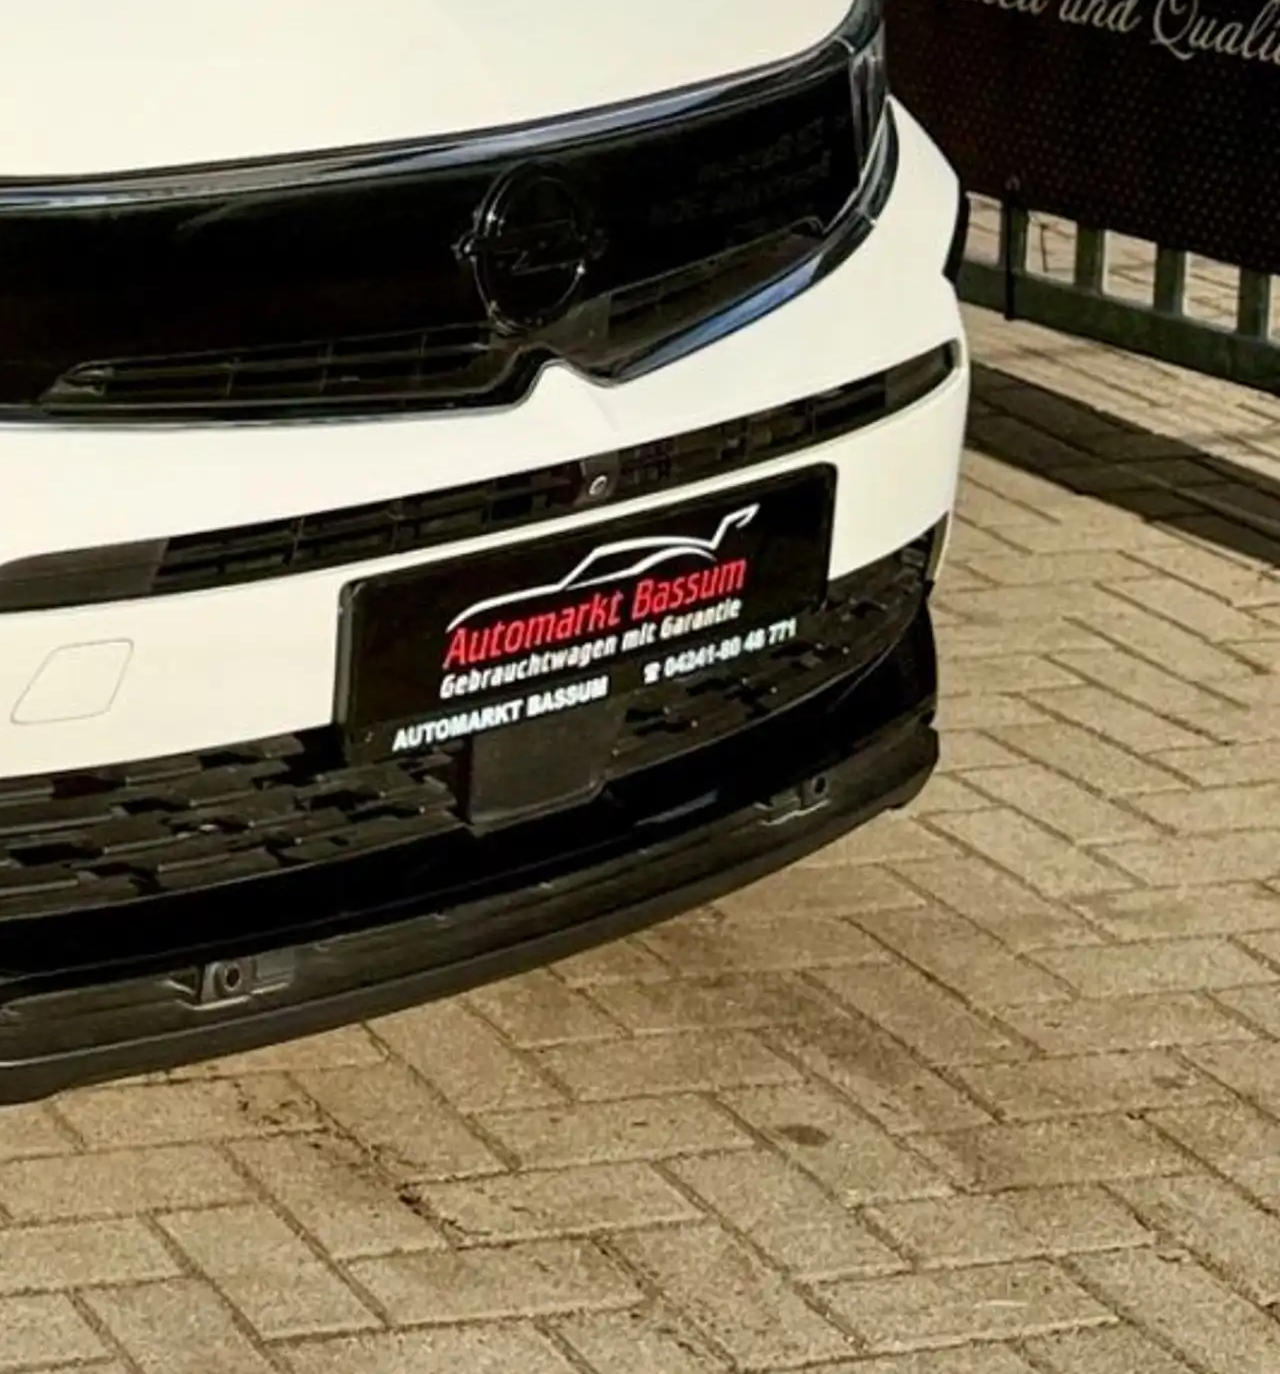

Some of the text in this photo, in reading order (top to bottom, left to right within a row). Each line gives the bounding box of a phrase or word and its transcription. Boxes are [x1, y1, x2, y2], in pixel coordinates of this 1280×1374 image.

[440, 598, 742, 699] Gebrauchtwagen mit Garantie
[442, 558, 746, 671] Automarkt Bassum
[392, 676, 609, 751] AUTOMARKT BASSUM
